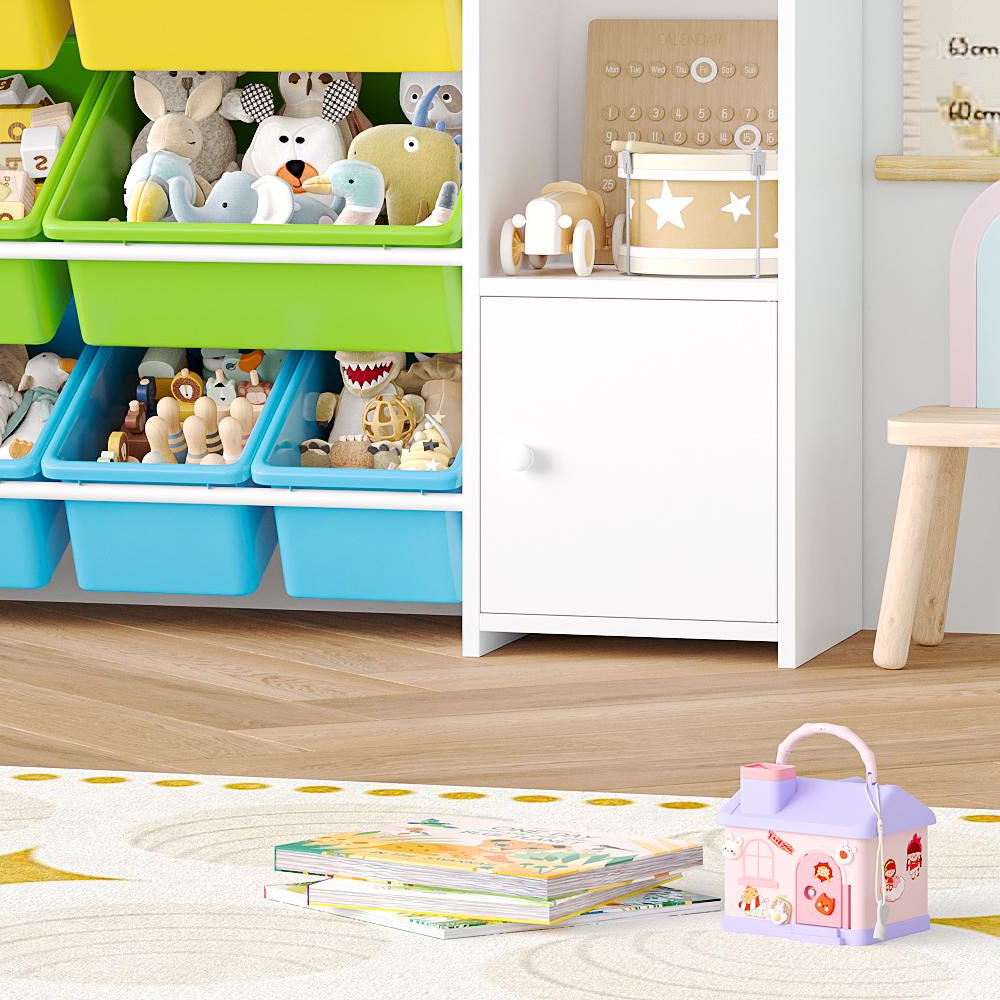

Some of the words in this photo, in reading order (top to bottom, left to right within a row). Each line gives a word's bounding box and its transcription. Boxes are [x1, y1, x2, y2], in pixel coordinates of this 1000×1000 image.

[699, 65, 708, 73] Fri
[721, 66, 732, 74] Sat
[744, 66, 756, 74] Sun
[630, 108, 636, 118] 2
[653, 108, 659, 118] 3
[676, 108, 682, 118] 4
[699, 108, 705, 118] 5
[721, 108, 728, 118] 6
[745, 108, 751, 118] 7
[768, 108, 774, 118] 8
[606, 132, 612, 141] 9
[652, 132, 658, 141] 11
[674, 132, 682, 142] 12
[697, 132, 705, 142] 13
[720, 132, 727, 142] 14
[743, 132, 751, 142] 15
[766, 132, 774, 142] 16
[604, 155, 612, 165] 17
[602, 180, 613, 189] 25
